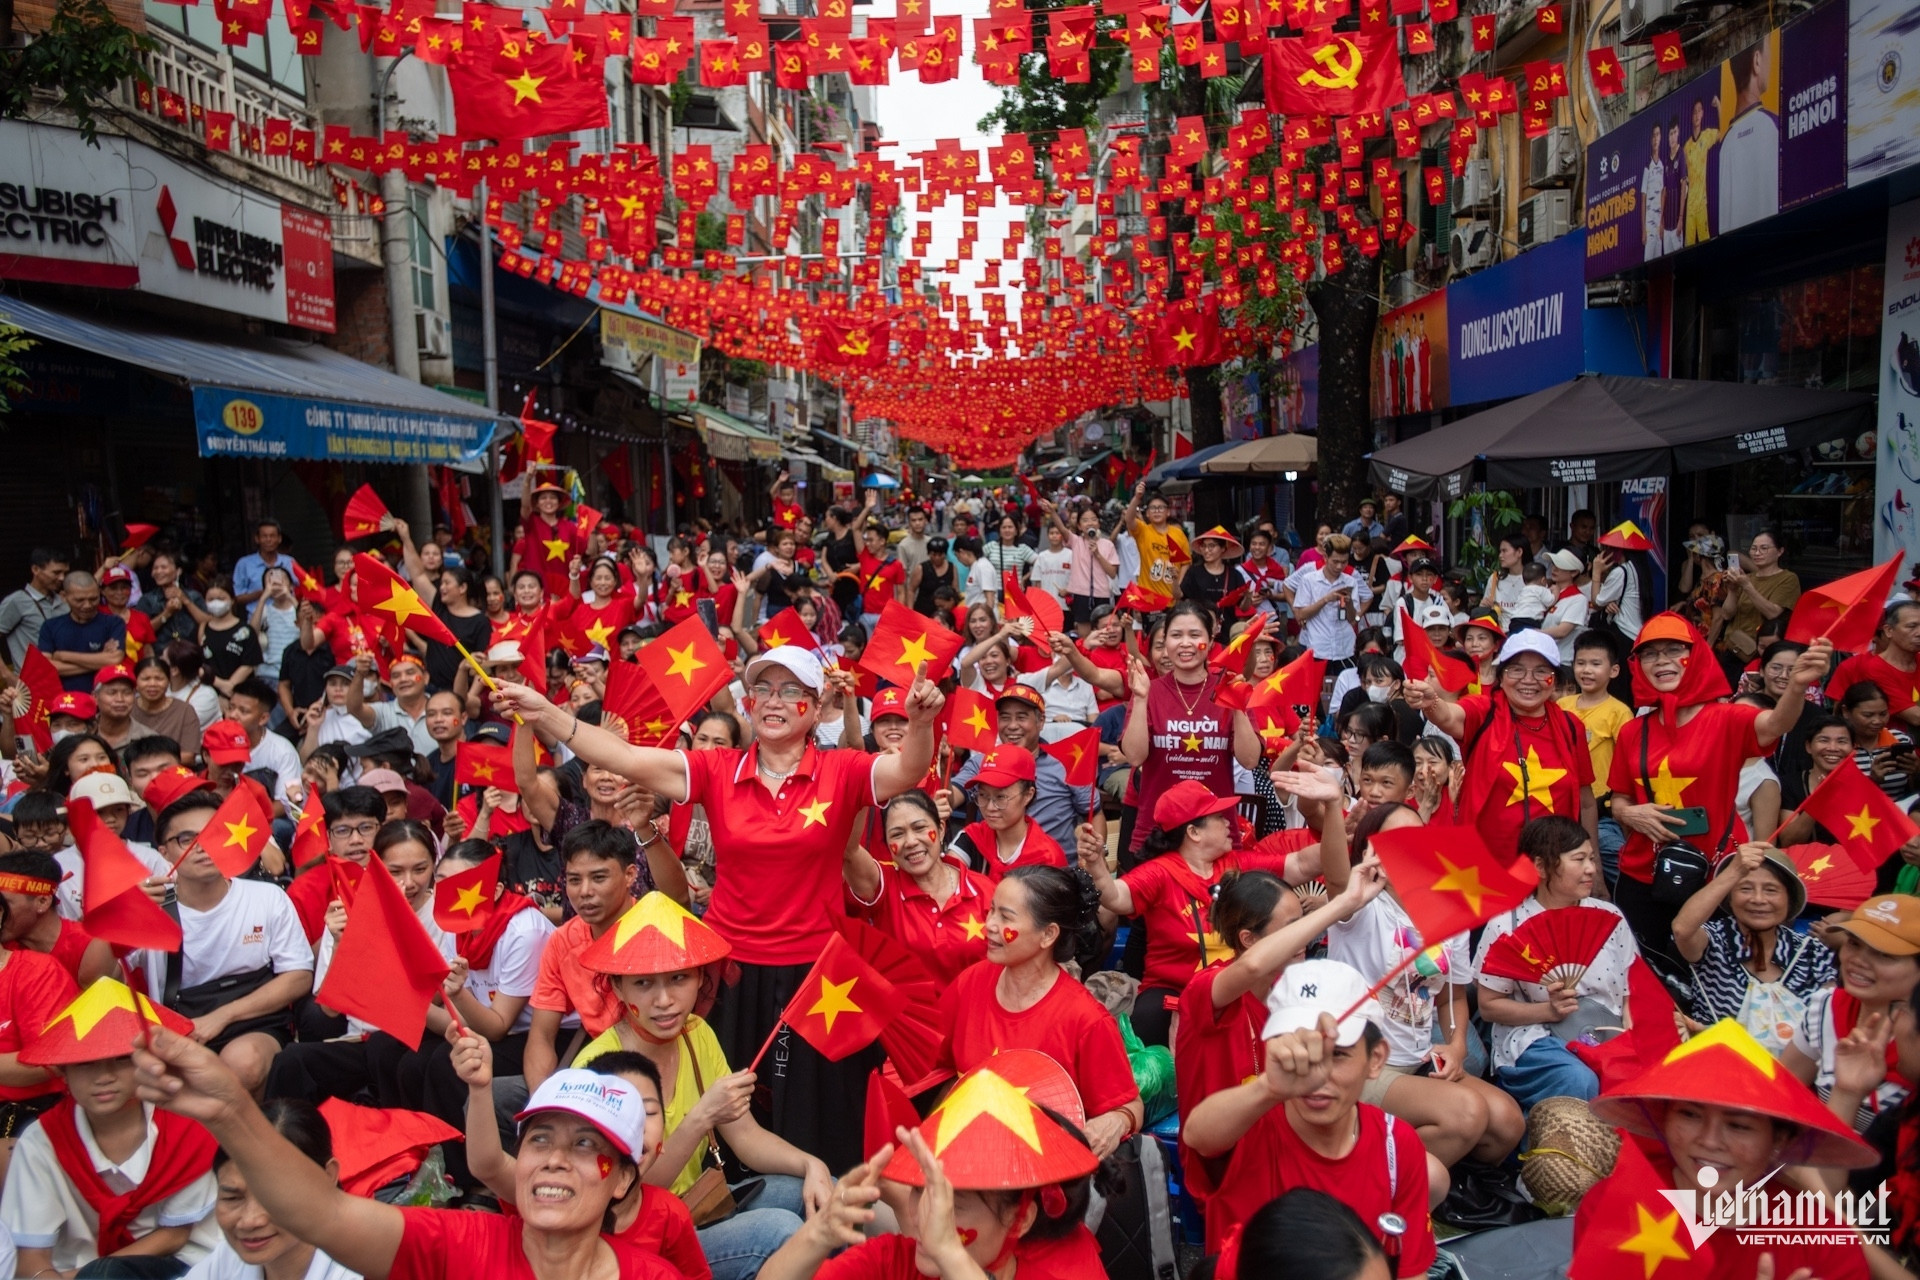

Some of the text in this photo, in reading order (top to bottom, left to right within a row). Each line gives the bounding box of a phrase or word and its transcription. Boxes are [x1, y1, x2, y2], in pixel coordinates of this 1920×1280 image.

[1788, 75, 1837, 112] CONTRAS
[1788, 94, 1837, 140] HANOI
[1621, 176, 1637, 190] JERSEY
[1587, 188, 1636, 230] CONTRAS
[193, 216, 283, 269] MITSUBISHI
[1587, 224, 1618, 257] HANOI
[197, 246, 275, 292] ELECTRIC
[1461, 292, 1563, 360] DONGLUCSPORT.VN
[232, 405, 257, 430] 139
[305, 405, 332, 428] CÔNG
[333, 411, 345, 429] TY
[1752, 430, 1769, 439] LINH
[1770, 427, 1785, 436] ANH
[248, 439, 267, 453] THÁI
[269, 440, 287, 455] HỌC
[1566, 461, 1581, 469] LINH
[1582, 459, 1596, 468] ANH
[1621, 476, 1666, 494] RACER
[1167, 715, 1218, 733] NGƯỜI
[1153, 734, 1229, 751] VIỆT NAM
[26, 881, 51, 893] NAM
